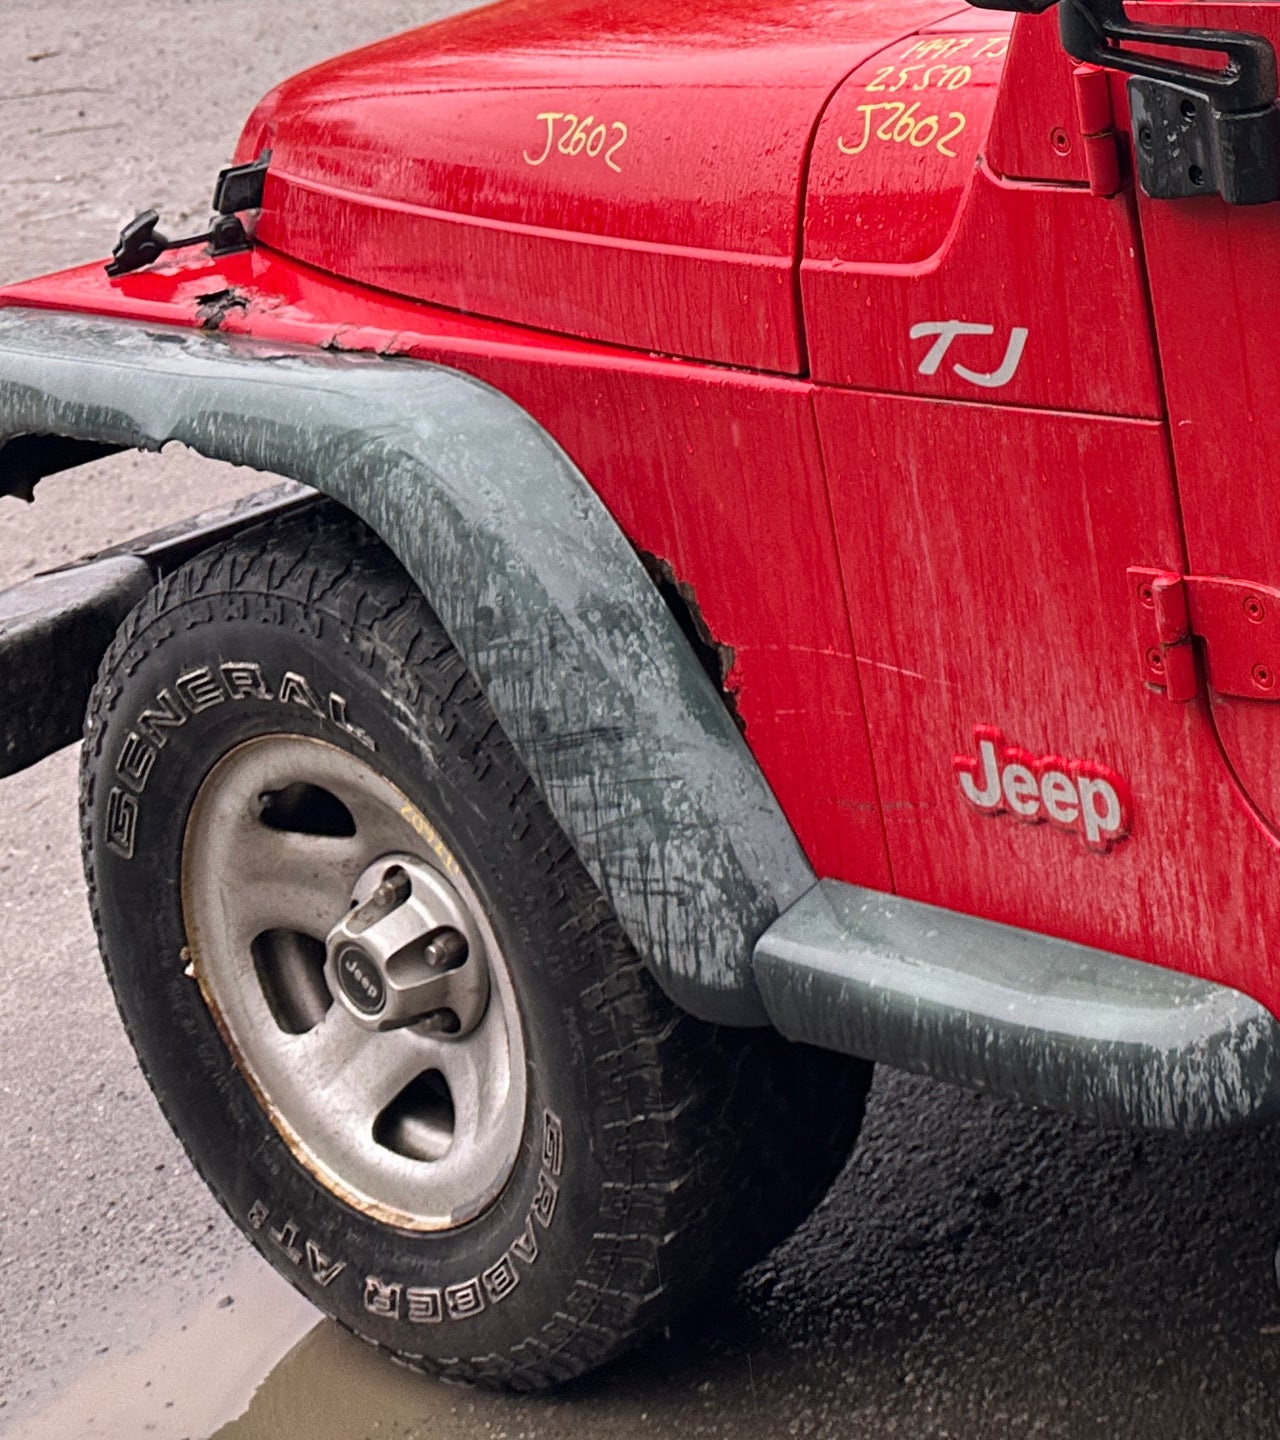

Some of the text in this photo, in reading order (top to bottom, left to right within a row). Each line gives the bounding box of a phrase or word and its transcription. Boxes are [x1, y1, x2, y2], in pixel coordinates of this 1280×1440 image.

[900, 37, 975, 59] 1997
[912, 64, 972, 91] STD
[522, 112, 630, 174] J2602
[837, 101, 966, 158] J2602
[909, 319, 1029, 389] TJ
[106, 661, 379, 860] GENERAL
[957, 737, 1124, 845] Jeep
[363, 1108, 564, 1323] GRABBER
